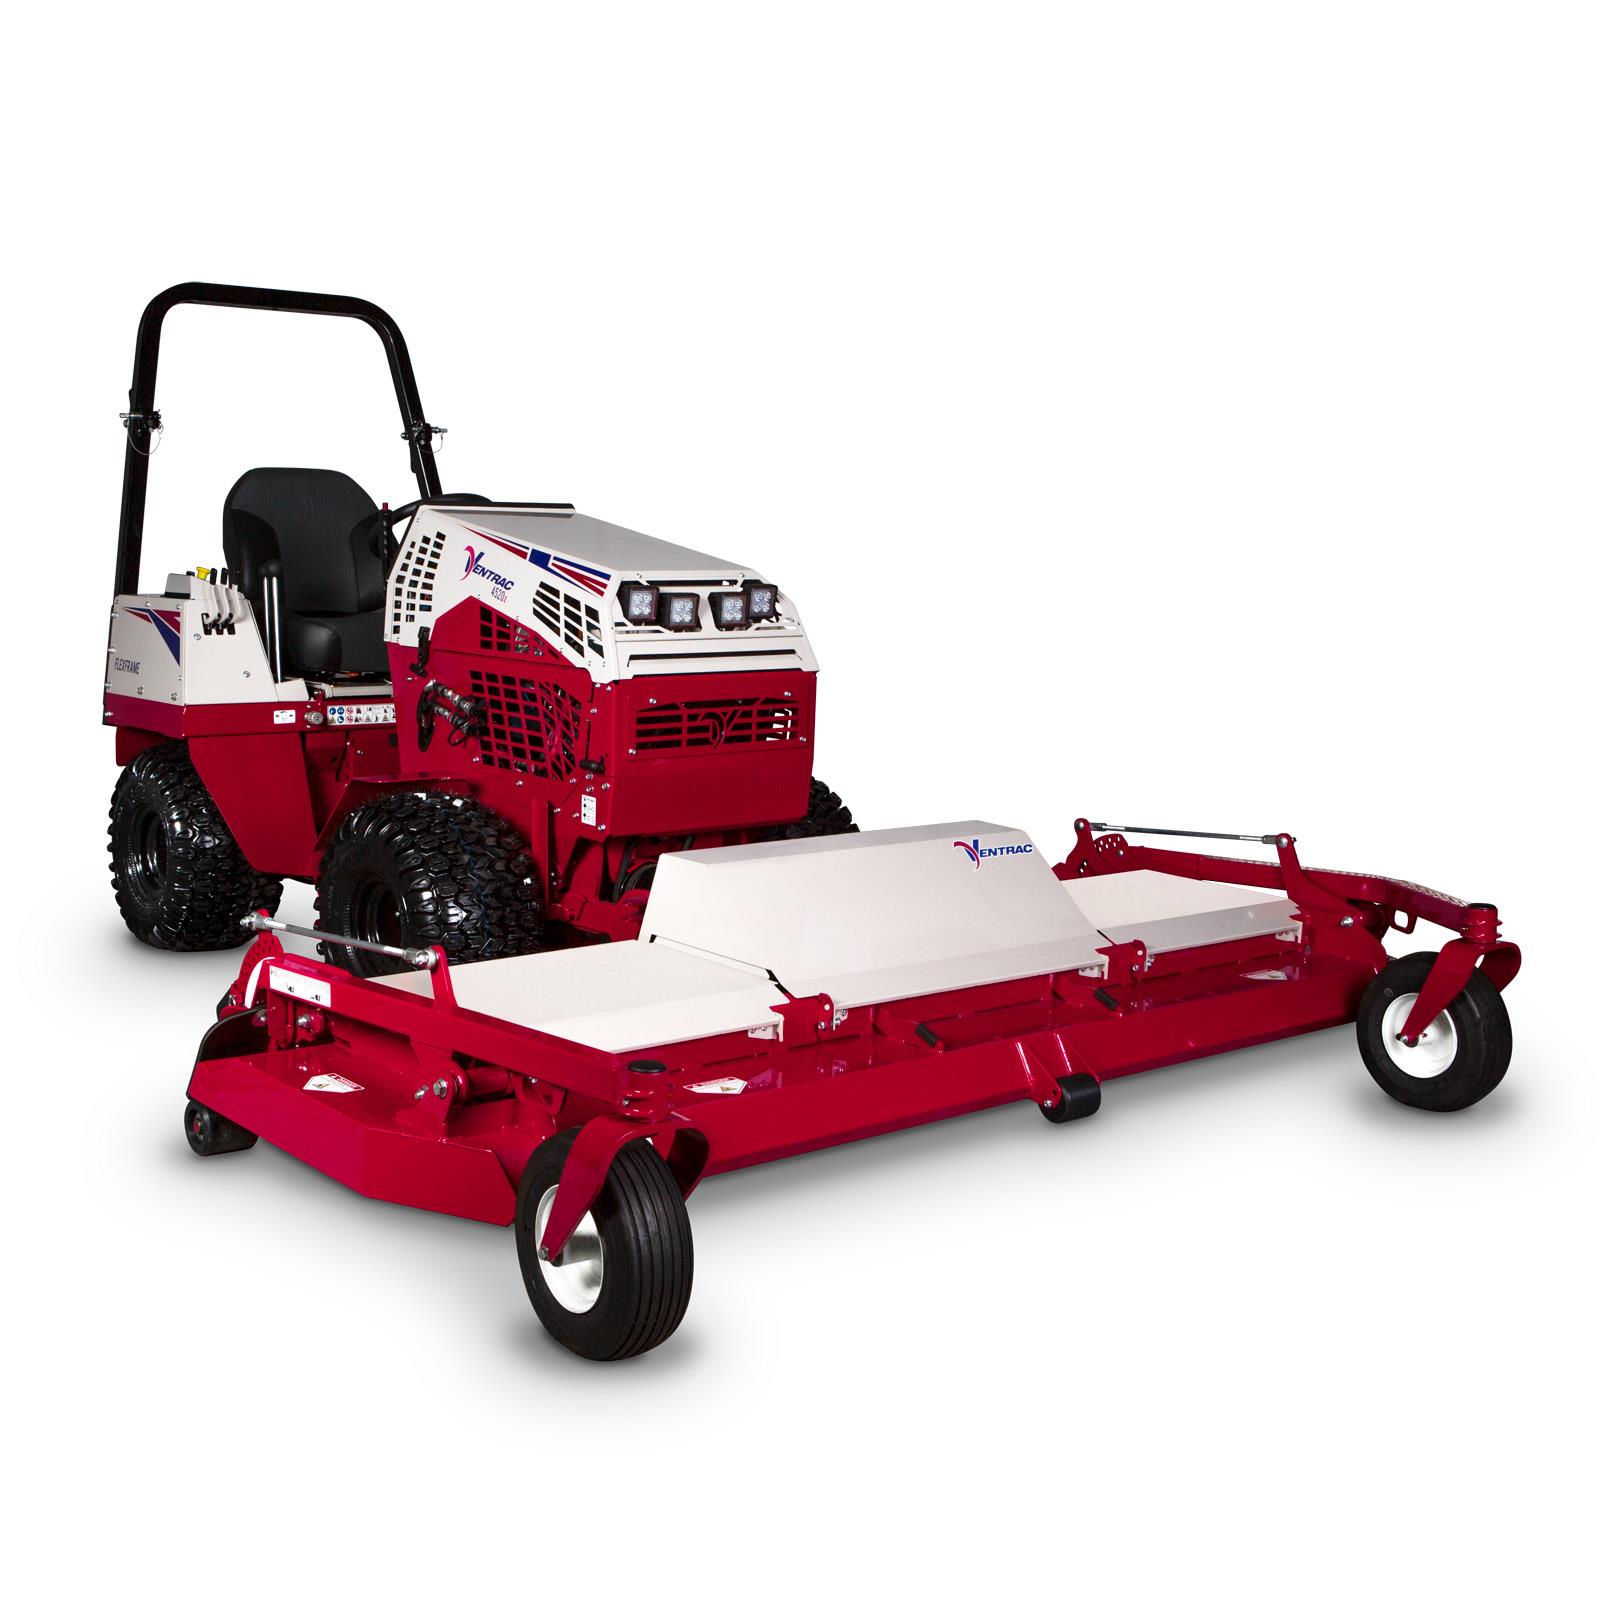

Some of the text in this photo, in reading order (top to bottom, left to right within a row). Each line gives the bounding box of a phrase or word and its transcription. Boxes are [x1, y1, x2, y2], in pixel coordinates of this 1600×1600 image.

[460, 545, 515, 591] VENTRAC
[114, 657, 141, 675] FLEXFRAME
[953, 839, 1033, 871] VENTRAC
